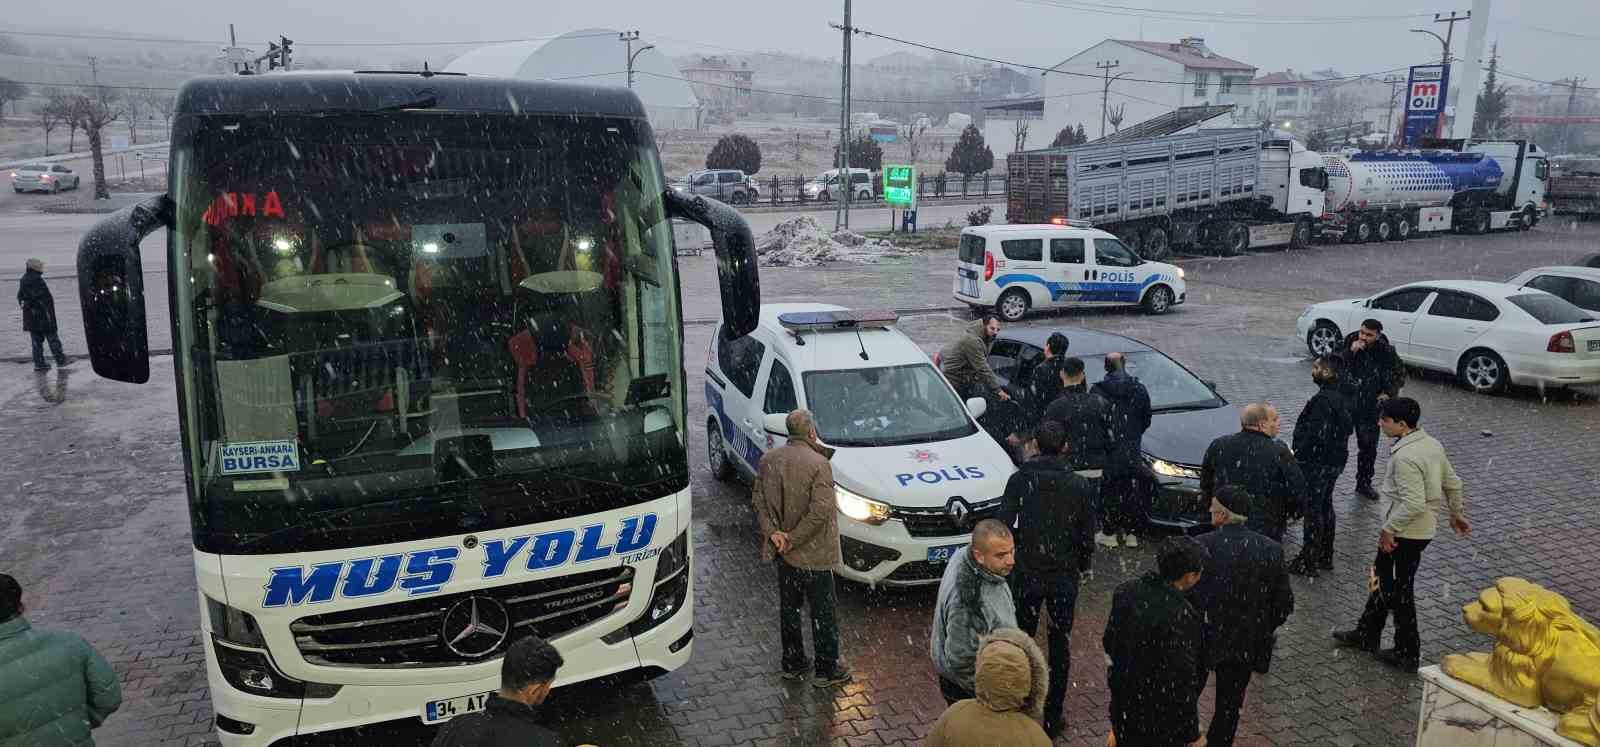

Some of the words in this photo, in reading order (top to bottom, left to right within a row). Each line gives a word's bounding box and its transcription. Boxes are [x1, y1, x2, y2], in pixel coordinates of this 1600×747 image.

[1412, 97, 1436, 108] oil
[1101, 270, 1135, 282] POLİS
[223, 455, 294, 470] BURSA
[896, 465, 985, 487] POLİS
[262, 545, 461, 608] MUŞ
[480, 512, 658, 578] YOLU
[935, 548, 949, 560] 23
[437, 701, 456, 716] 34
[467, 695, 488, 711] AT
